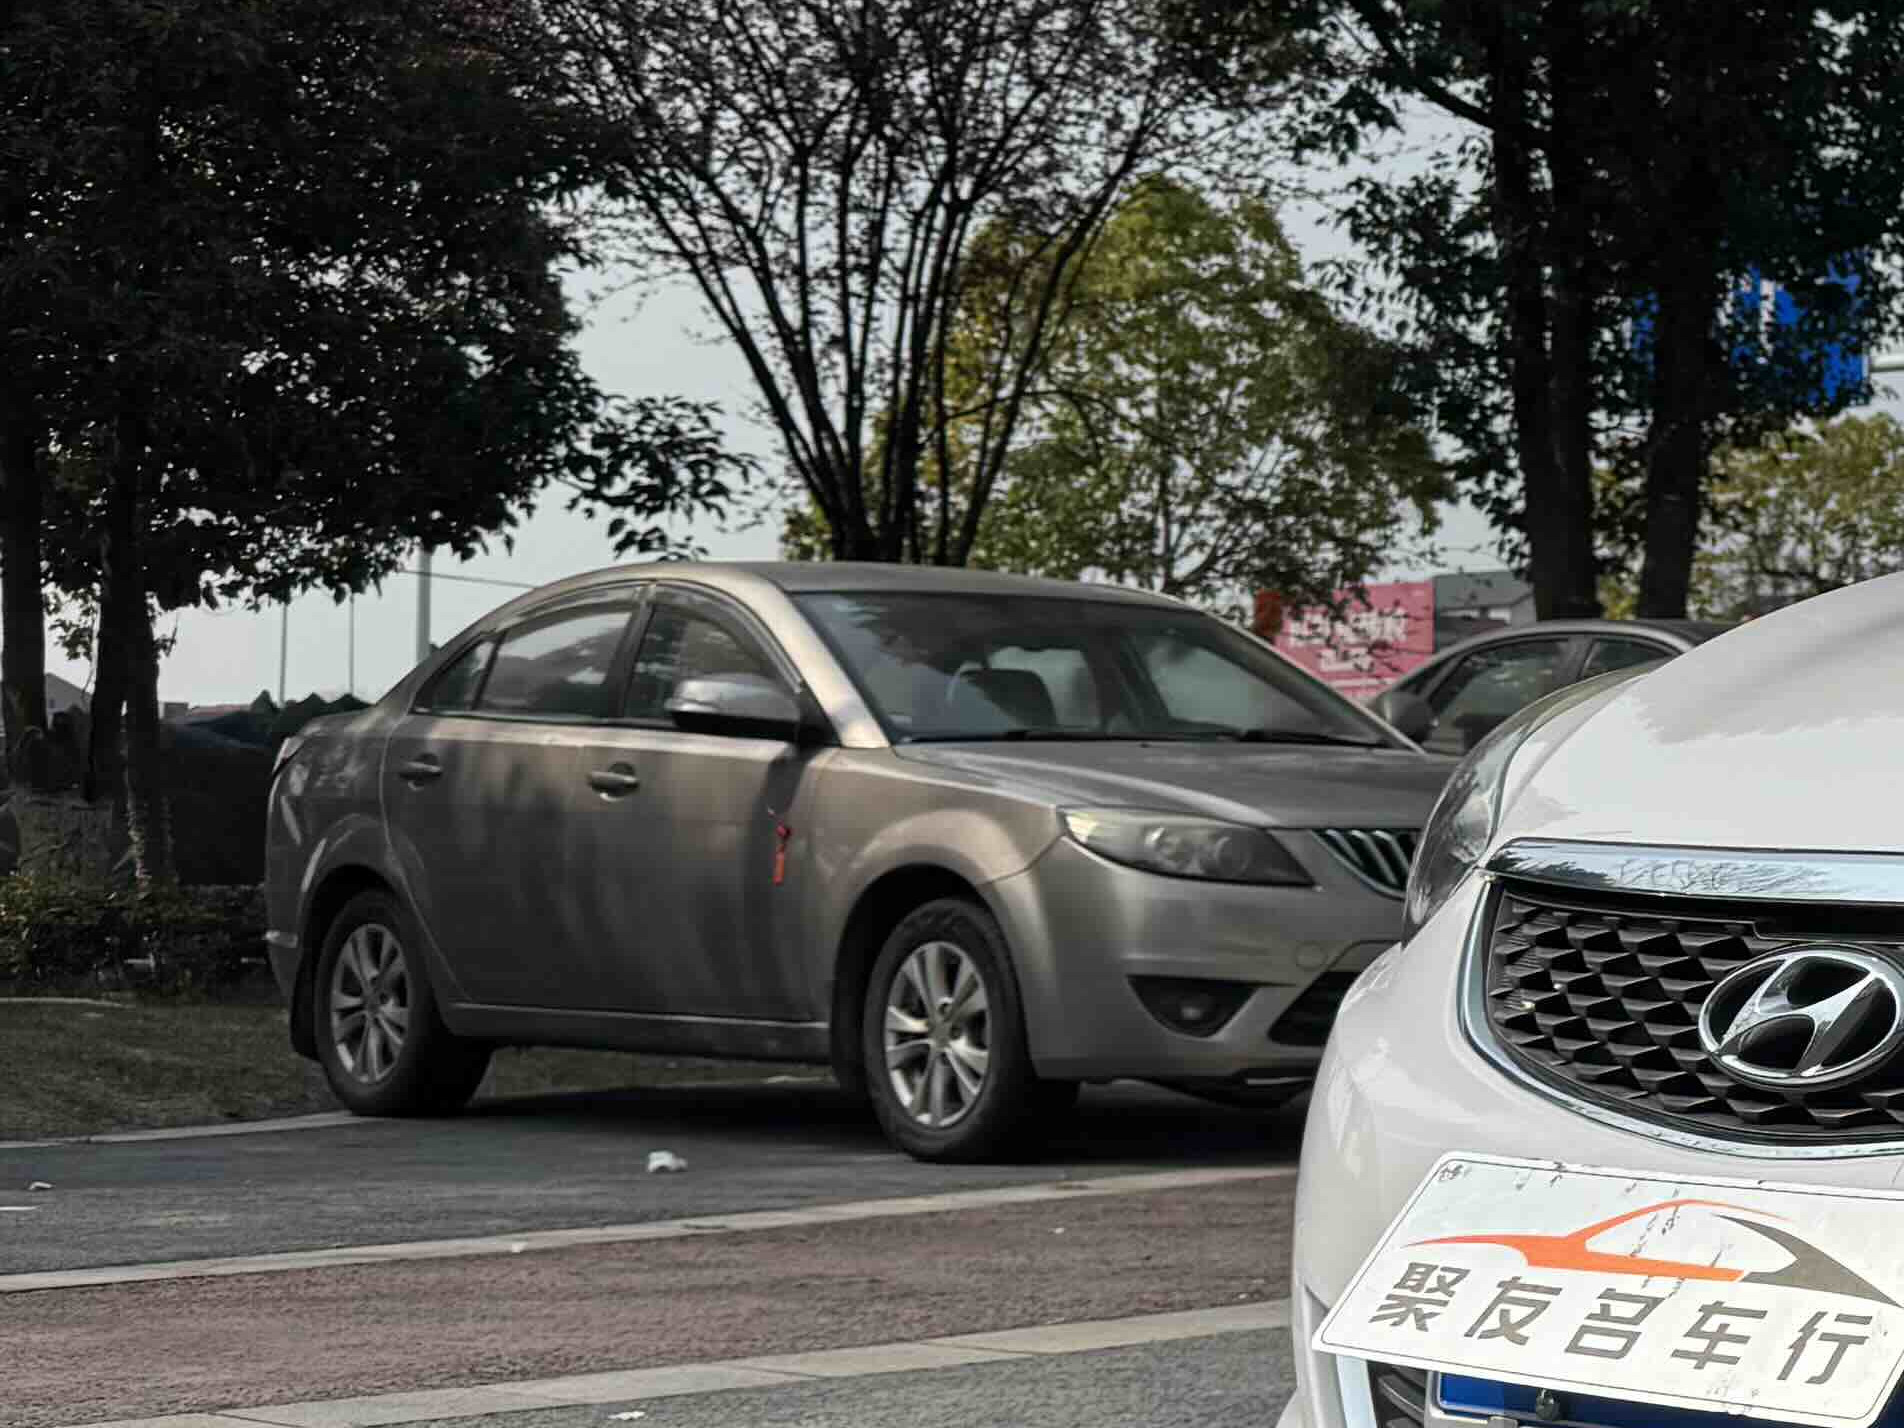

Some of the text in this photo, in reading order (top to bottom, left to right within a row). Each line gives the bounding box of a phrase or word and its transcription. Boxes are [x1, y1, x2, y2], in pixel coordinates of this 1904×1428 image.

[1368, 1261, 1874, 1385] 聚友名车行
